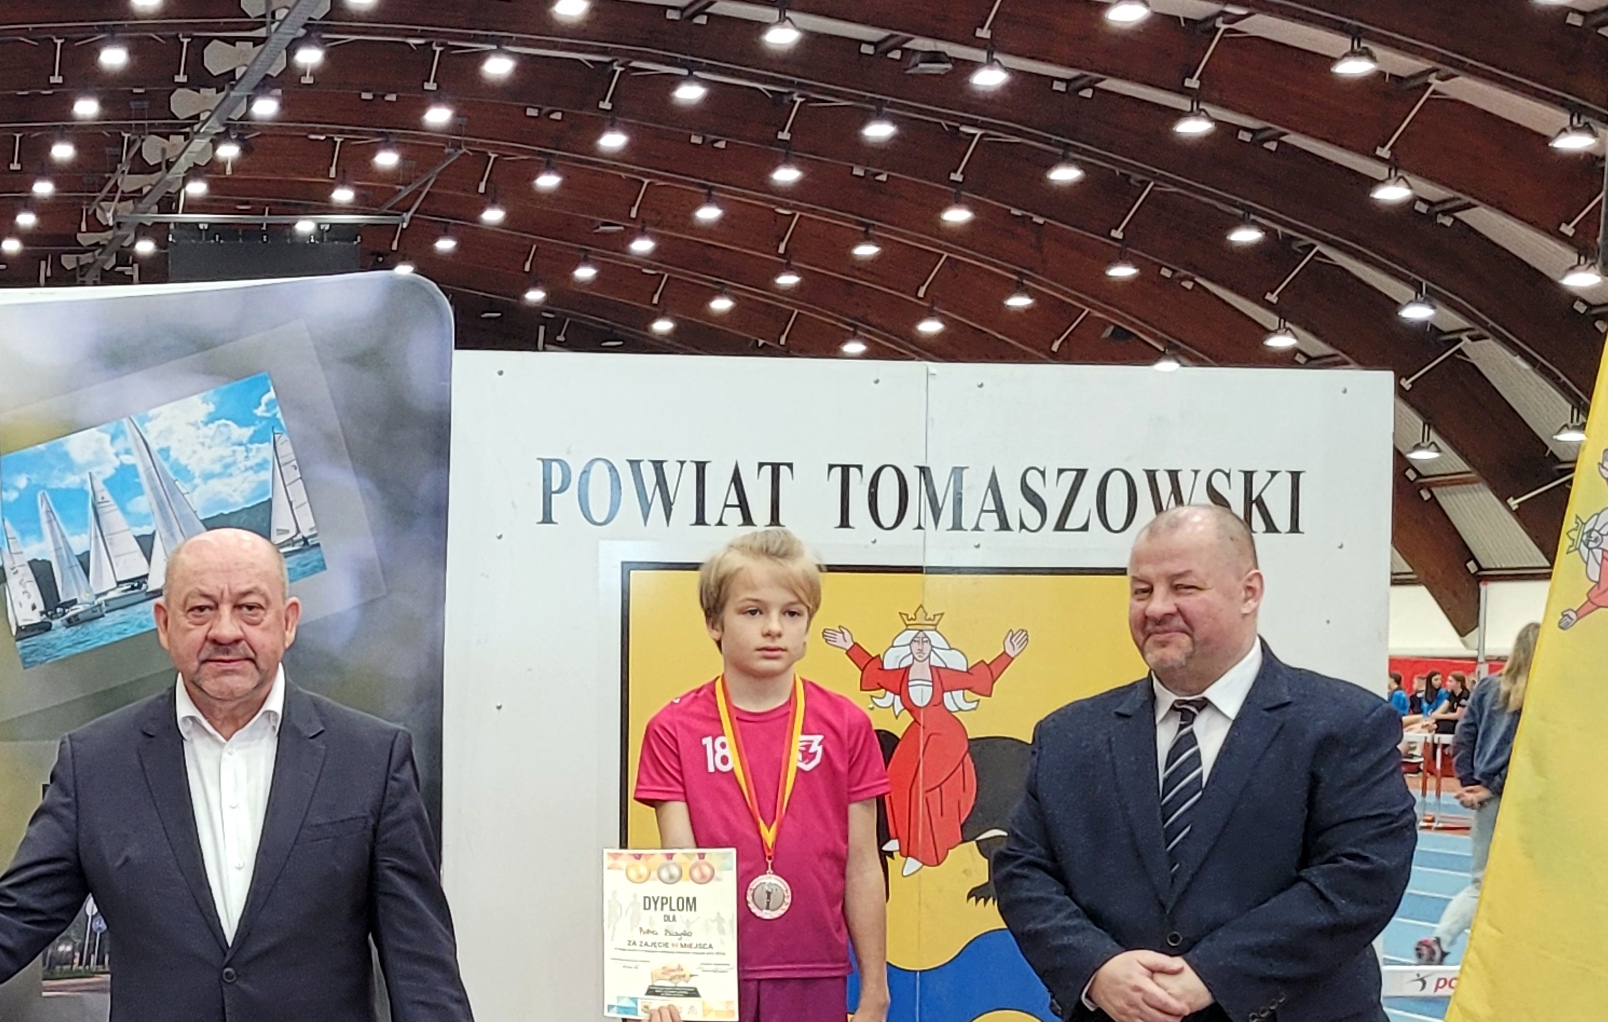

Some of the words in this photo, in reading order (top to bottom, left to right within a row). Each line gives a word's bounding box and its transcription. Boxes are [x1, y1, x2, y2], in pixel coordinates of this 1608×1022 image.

[536, 457, 794, 528] POWIAT
[827, 463, 1306, 534] TOMASZOWSKI
[702, 735, 735, 773] 18
[642, 896, 697, 912] DYPLOM
[663, 914, 677, 923] DLA
[680, 942, 714, 950] MIEJSCA
